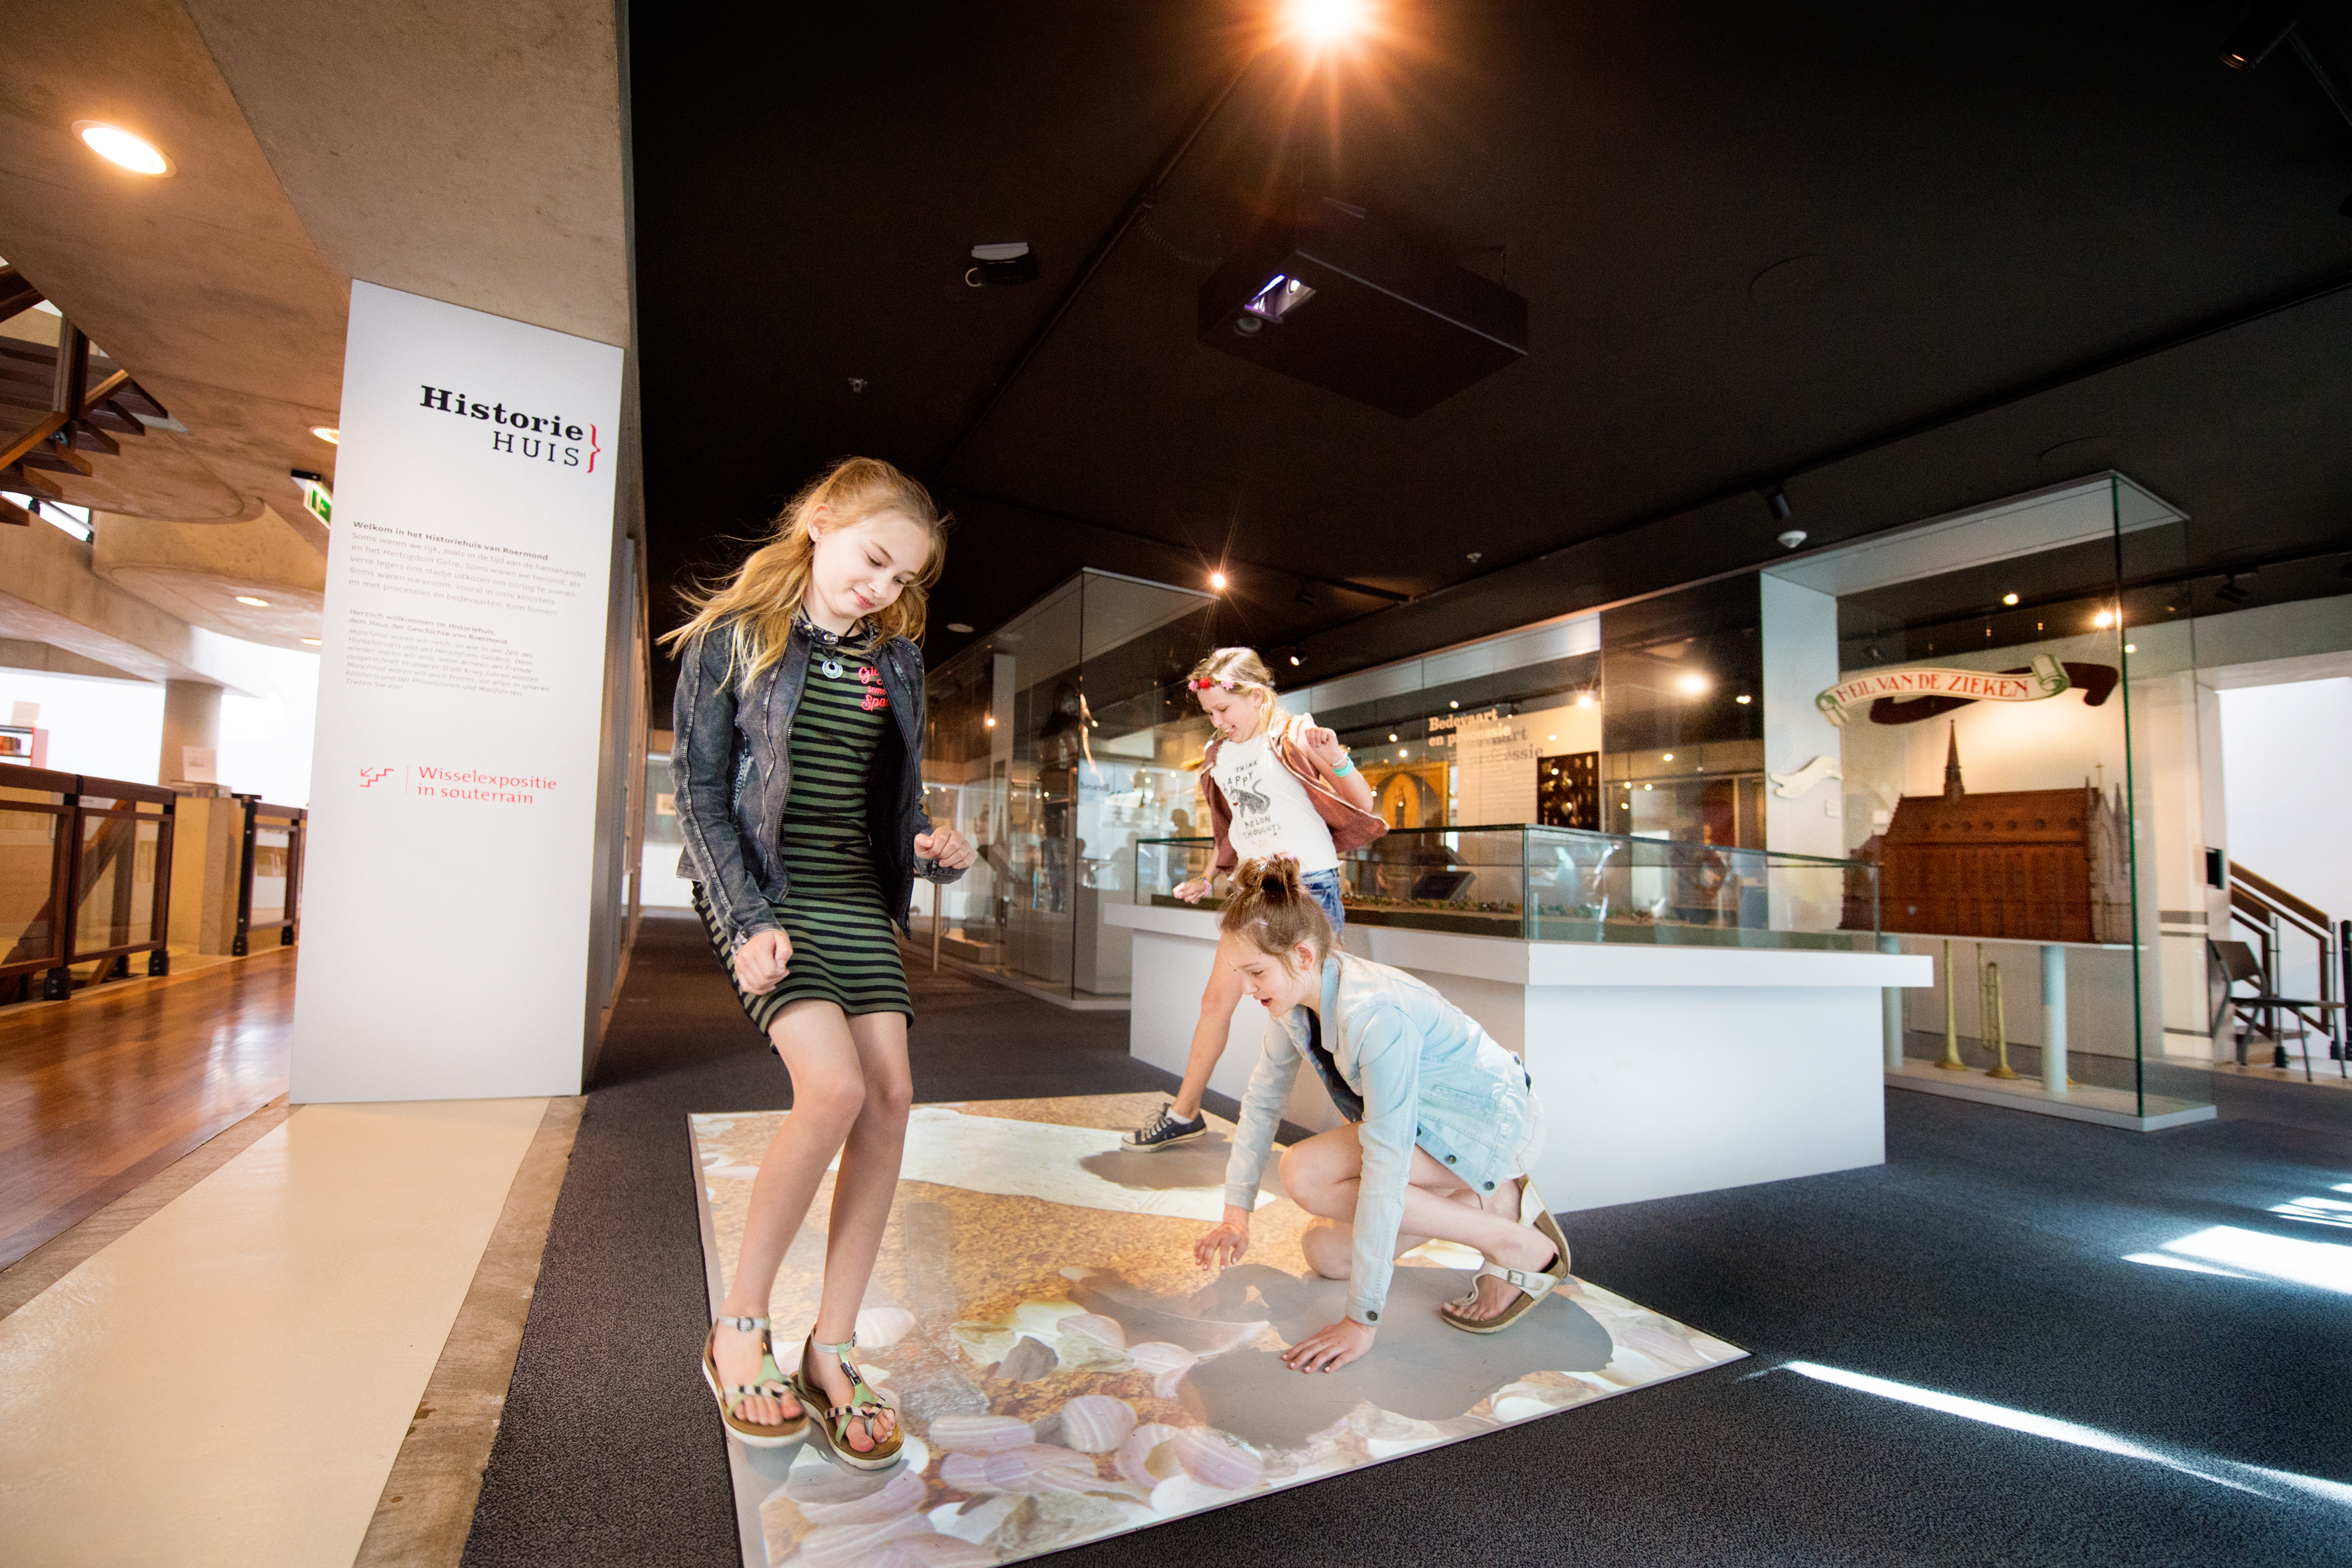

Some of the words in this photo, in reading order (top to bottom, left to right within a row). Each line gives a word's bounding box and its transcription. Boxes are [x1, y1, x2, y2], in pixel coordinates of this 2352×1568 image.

[420, 384, 584, 441] Historie
[492, 431, 579, 467] HUIS
[353, 521, 393, 533] Welkom
[407, 530, 422, 539] het
[426, 534, 482, 549] Historiehuis
[503, 548, 548, 560] Roermond
[352, 532, 377, 542] Soms
[379, 538, 407, 547] waren
[535, 564, 586, 578] hanzehandel
[365, 546, 380, 554] het
[383, 550, 434, 563] Hertogdom
[465, 563, 489, 572] Soms
[349, 567, 375, 577] Soms
[376, 572, 405, 581] waren
[517, 593, 555, 605] kloosters
[350, 556, 374, 565] verre
[376, 559, 404, 570] legers
[425, 568, 452, 578] stadje
[454, 573, 491, 584] uitkozen
[508, 582, 536, 593] oorlog
[383, 585, 431, 597] processies
[350, 609, 384, 619] Herzlich
[386, 615, 434, 625] willkommen
[407, 625, 451, 637] Geschichte
[469, 634, 508, 645] Roermond
[1836, 680, 1877, 702] HEIL
[1876, 674, 1913, 693] VAN
[1919, 674, 1941, 690] DE
[1948, 675, 2030, 698] ZIEKEN
[1429, 708, 1498, 732] Bedevaart
[1429, 735, 1445, 747] en
[1448, 722, 1512, 747] processie
[419, 766, 558, 791] Wisselexpositie
[418, 783, 434, 796] in
[441, 787, 534, 805] souterrain
